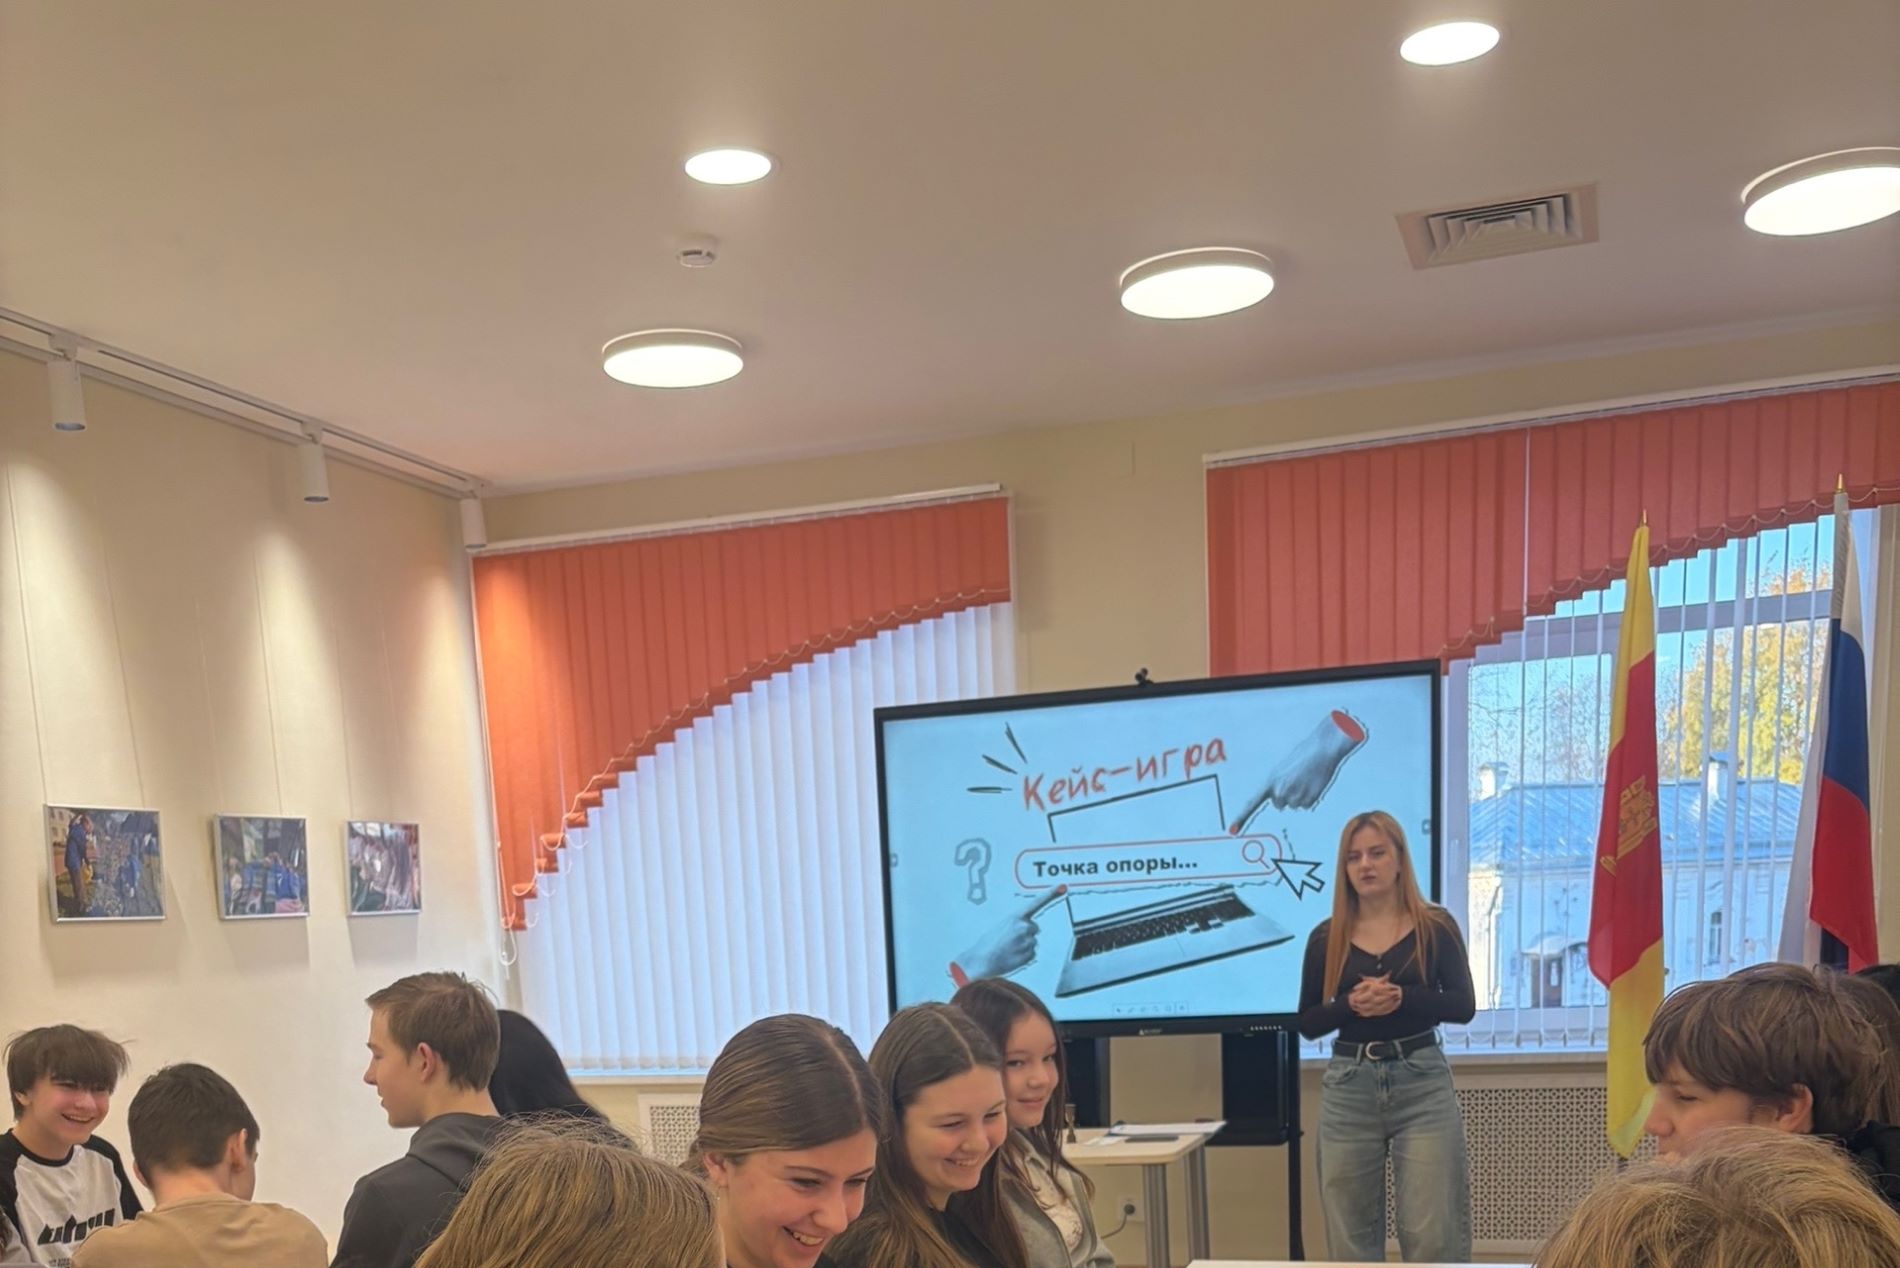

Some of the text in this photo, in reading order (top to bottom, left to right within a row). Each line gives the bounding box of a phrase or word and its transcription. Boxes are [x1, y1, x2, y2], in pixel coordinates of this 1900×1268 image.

[1023, 737, 1227, 811] Кейс-игра
[1033, 856, 1199, 878] Точка опоры...
